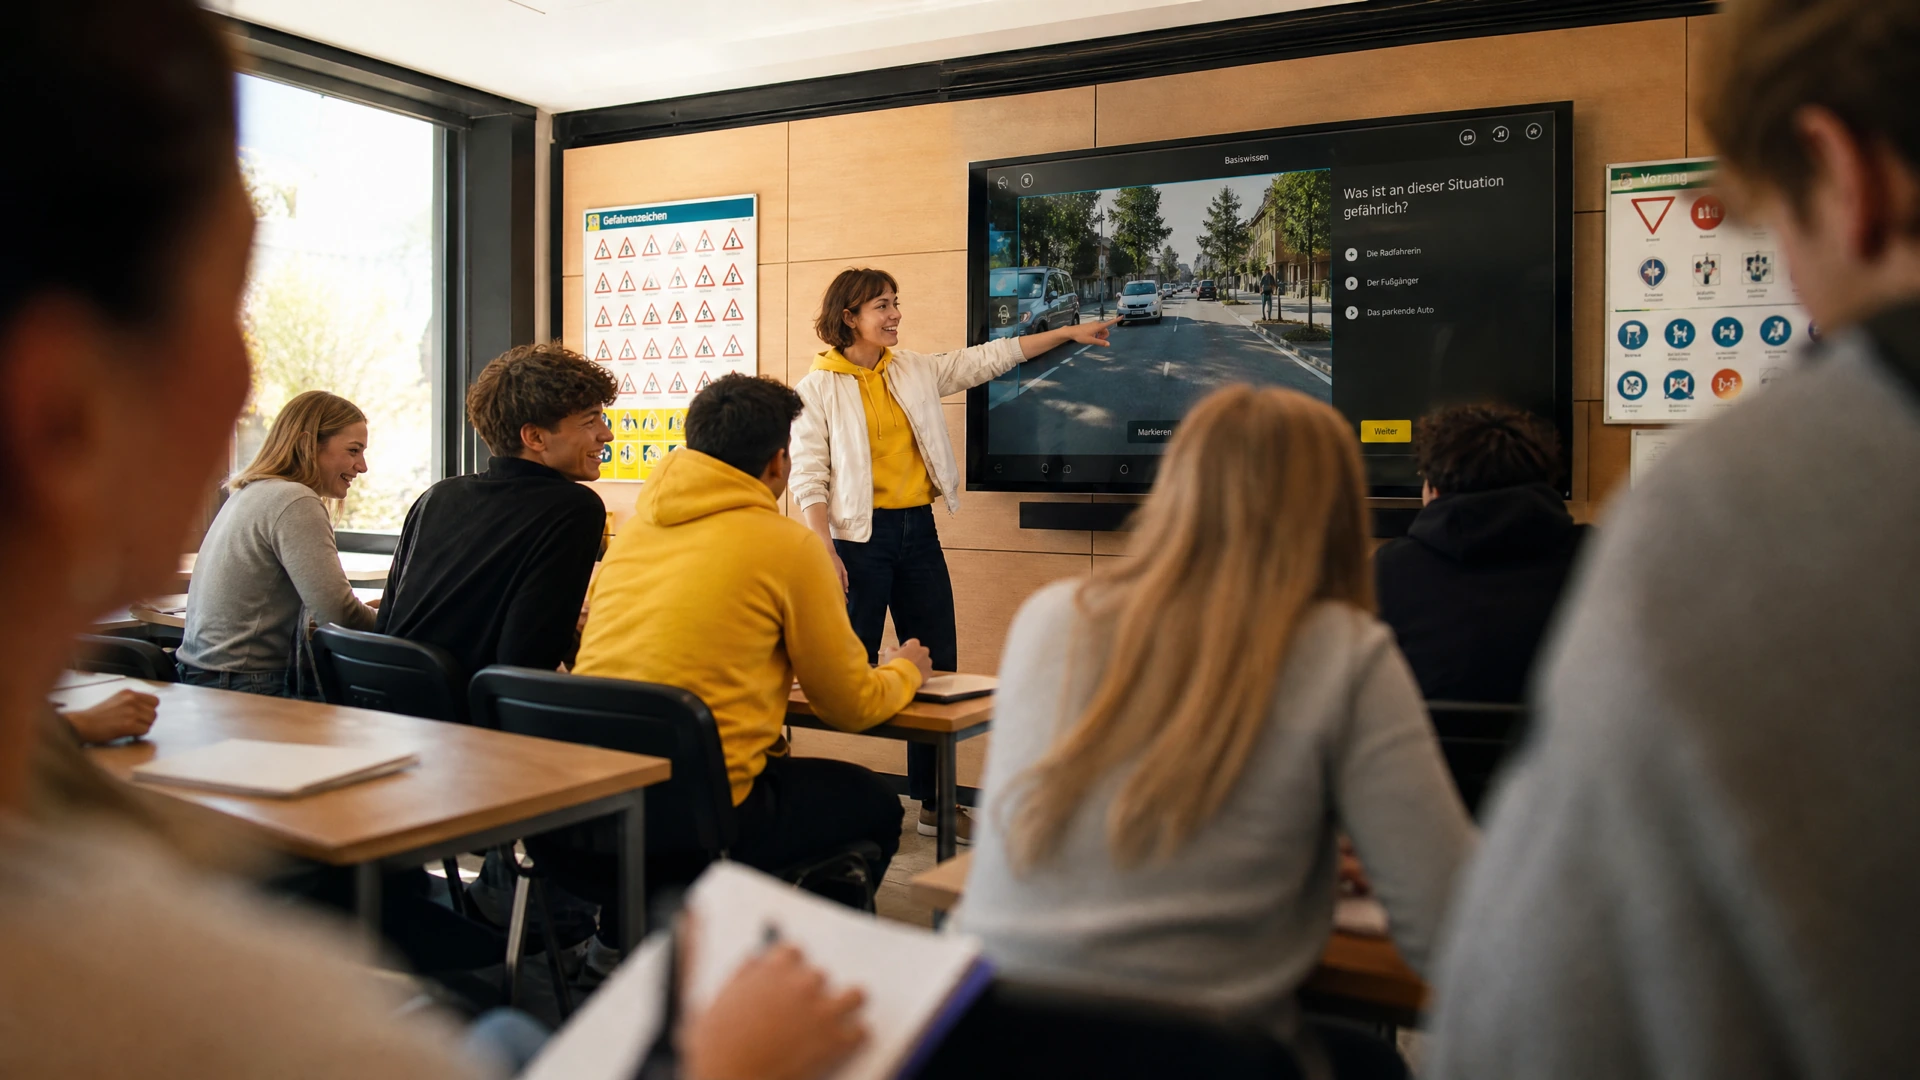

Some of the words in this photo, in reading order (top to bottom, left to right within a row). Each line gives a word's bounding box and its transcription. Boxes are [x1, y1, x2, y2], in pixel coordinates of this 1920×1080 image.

[1224, 154, 1269, 165] Basiswissen
[1641, 172, 1688, 186] Vorrang
[1344, 187, 1369, 199] Was
[1372, 185, 1386, 197] ist
[1389, 185, 1404, 196] an
[1407, 181, 1445, 194] dieser
[1448, 175, 1504, 191] Situation
[1344, 201, 1409, 220] gefährlich?
[603, 211, 667, 225] Gefahrenzeichen
[1366, 249, 1379, 258] Die
[1380, 246, 1421, 257] Radfahrerin
[1366, 279, 1379, 287] Der
[1367, 308, 1380, 316] Das
[1382, 306, 1416, 317] parkende
[1417, 306, 1434, 314] Auto
[1137, 427, 1172, 436] Markieren
[1374, 427, 1398, 435] Weiter
